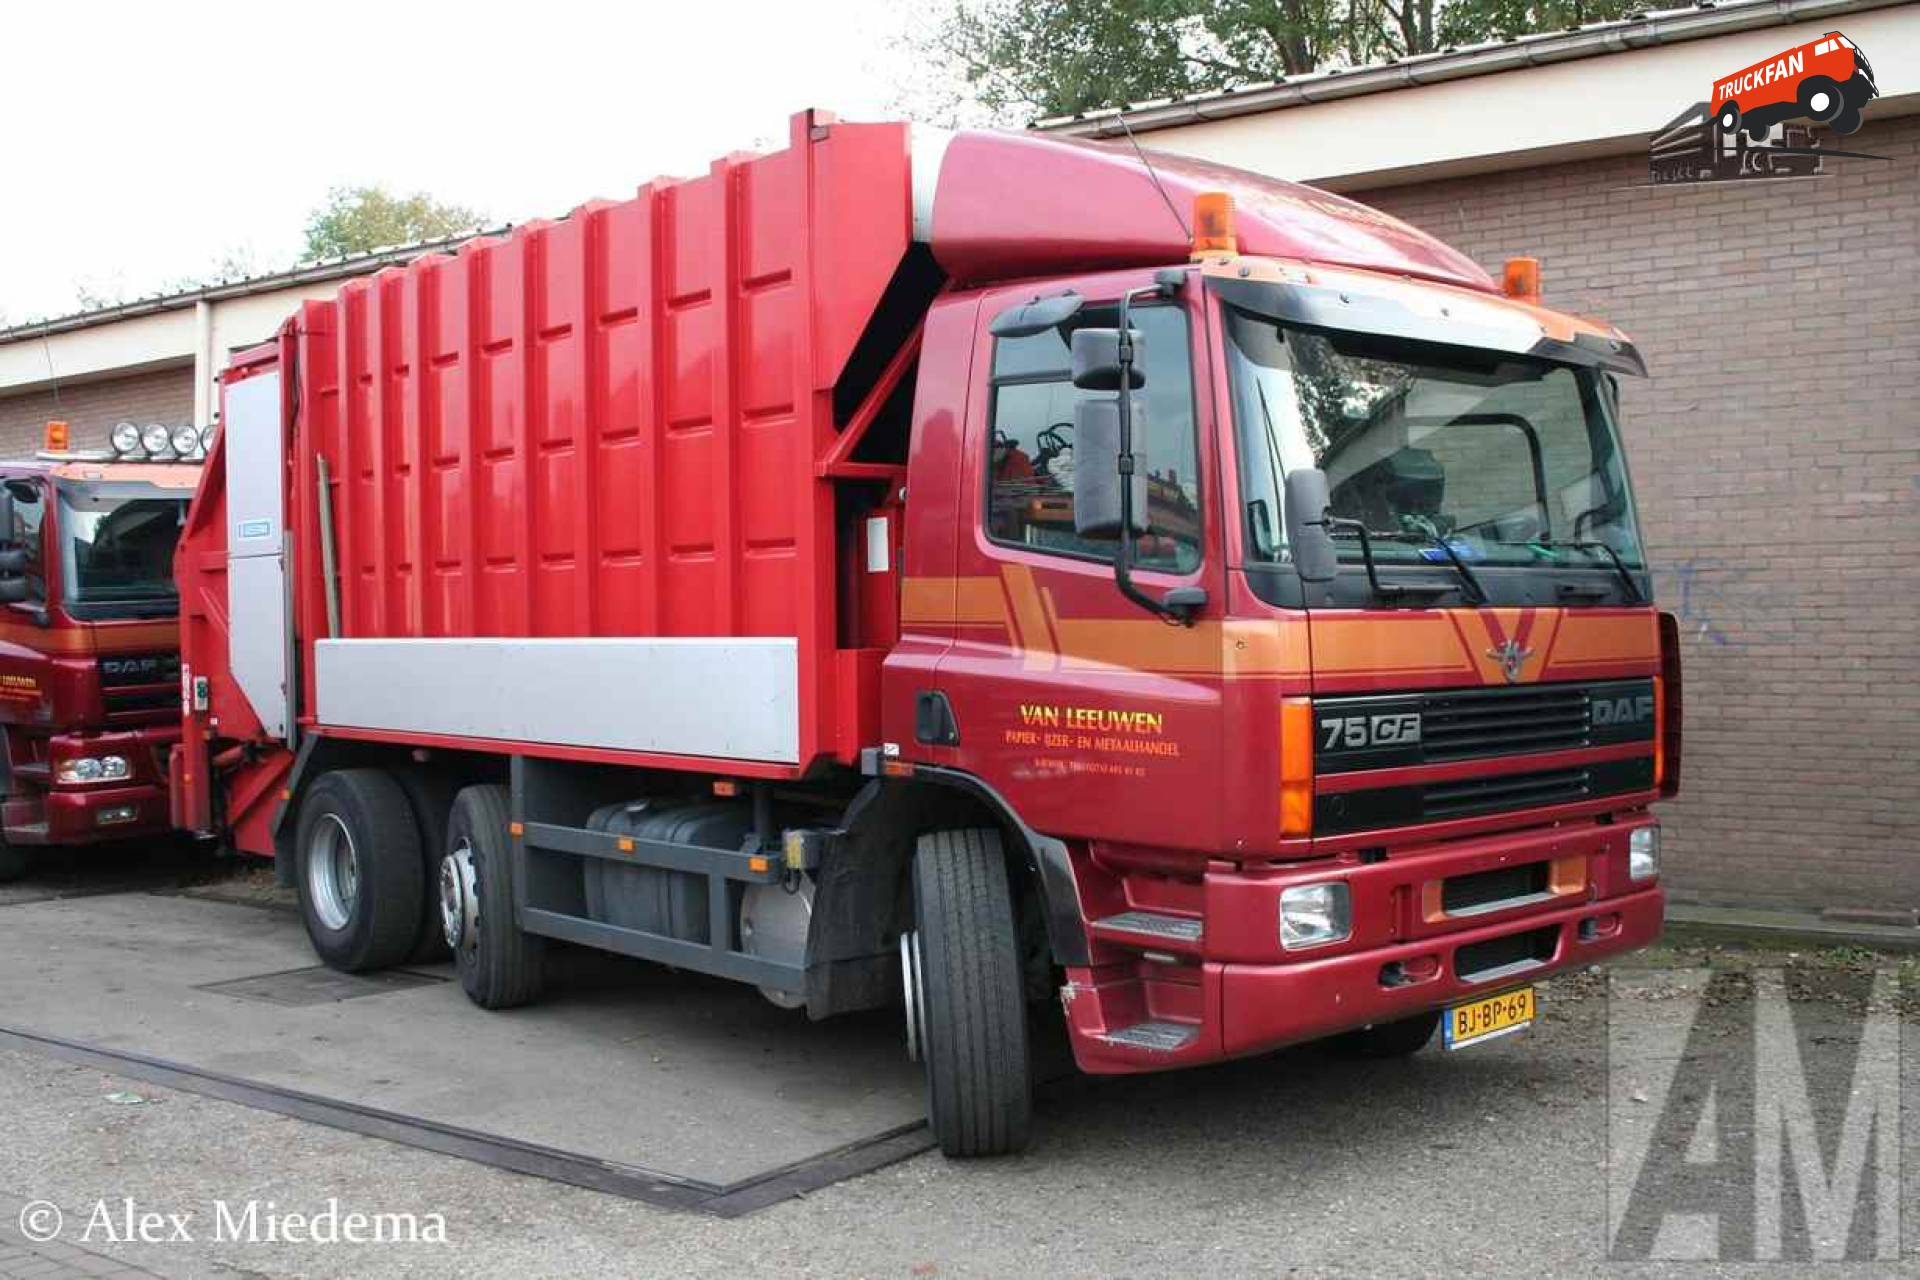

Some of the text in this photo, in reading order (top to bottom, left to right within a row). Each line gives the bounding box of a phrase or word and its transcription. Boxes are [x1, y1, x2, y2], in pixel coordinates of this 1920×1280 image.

[1020, 703, 1163, 734] VAN LEEUWEN
[1591, 696, 1654, 725] DAF
[1077, 735, 1094, 750] EN
